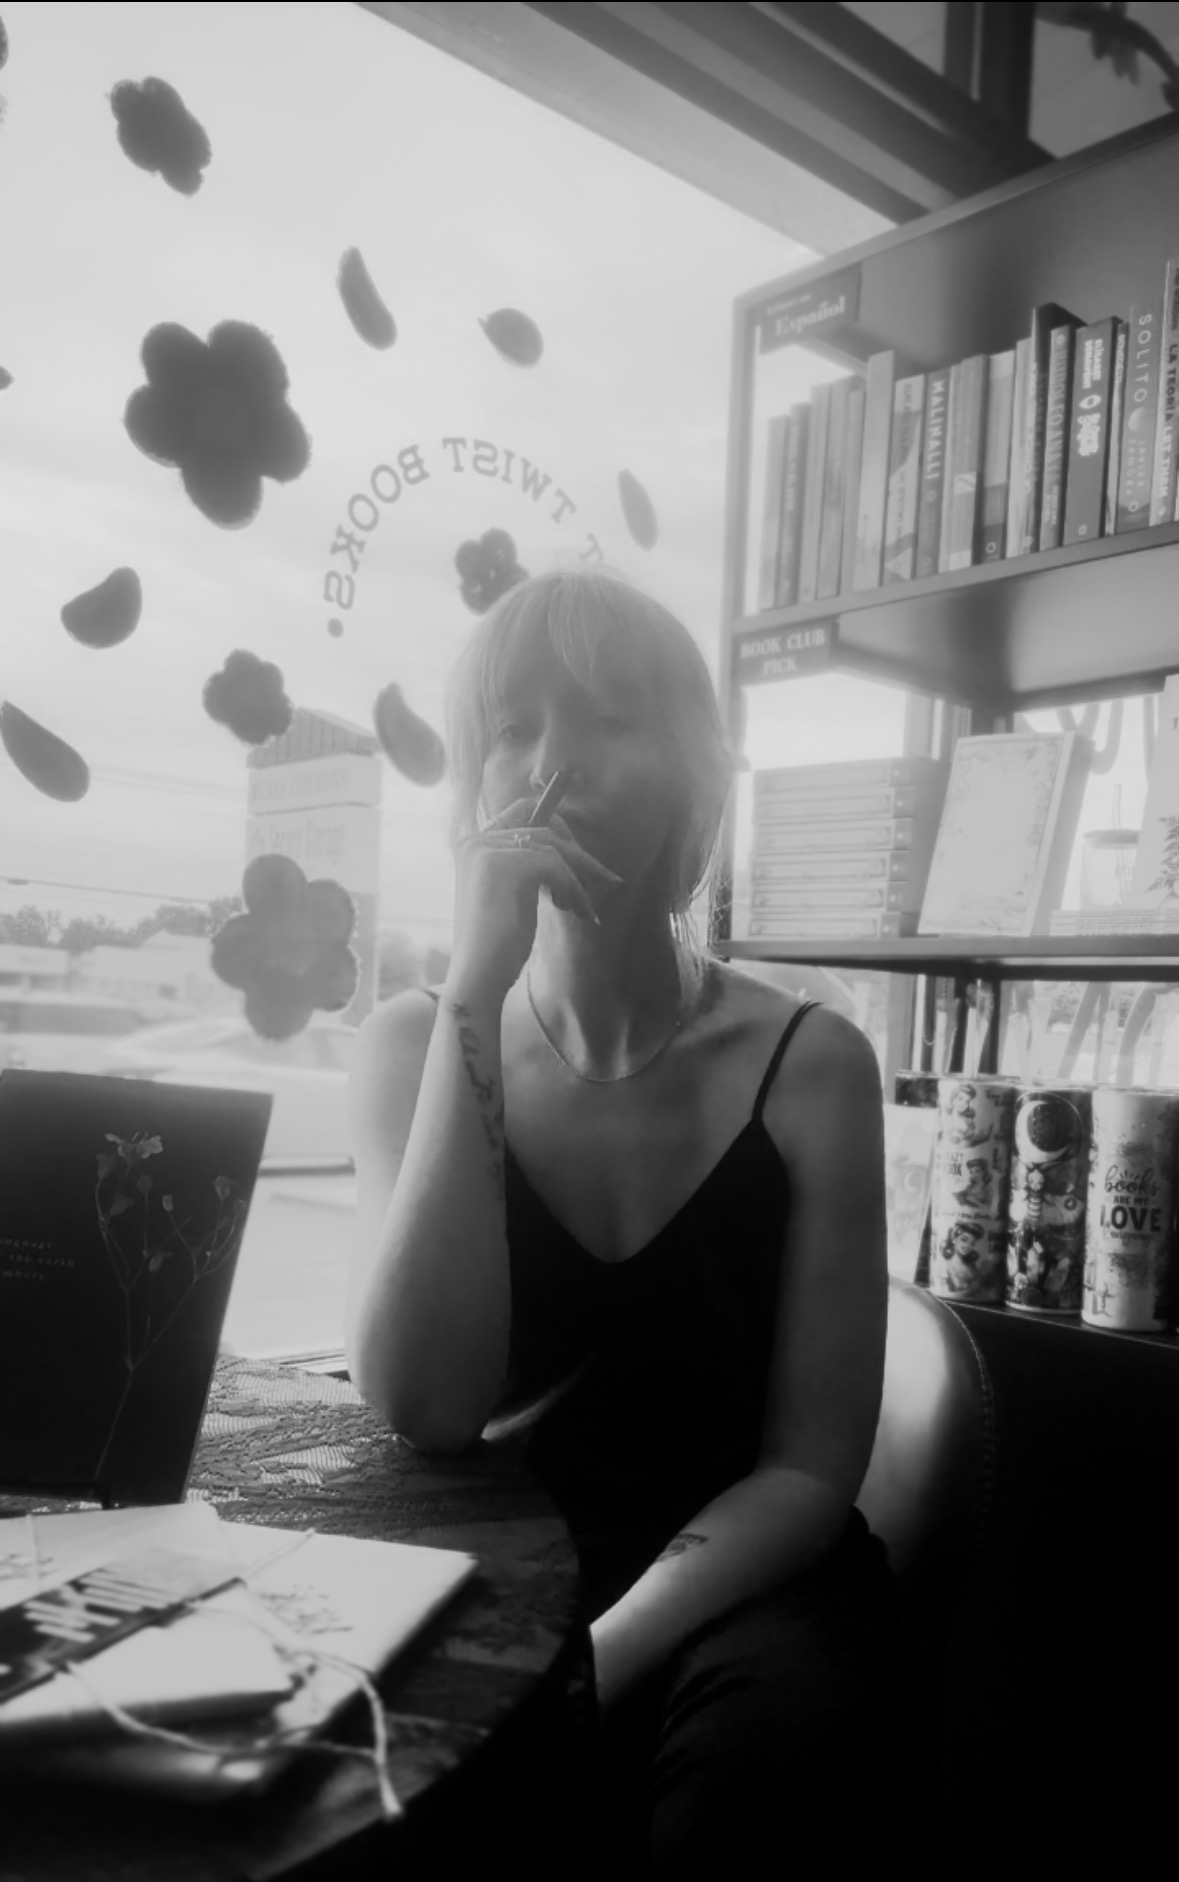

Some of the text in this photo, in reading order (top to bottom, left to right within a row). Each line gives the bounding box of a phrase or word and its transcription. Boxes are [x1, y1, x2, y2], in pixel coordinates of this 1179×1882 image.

[776, 293, 845, 335] Español
[1134, 314, 1152, 403] SOLITO
[1167, 344, 1178, 364] LA
[926, 380, 945, 480] MALINALLI
[1163, 426, 1173, 452] LET
[1159, 457, 1171, 498] THEM
[740, 628, 826, 659] BOOK CLUB
[763, 656, 798, 677] PICK
[1100, 1204, 1163, 1233] LOVE
